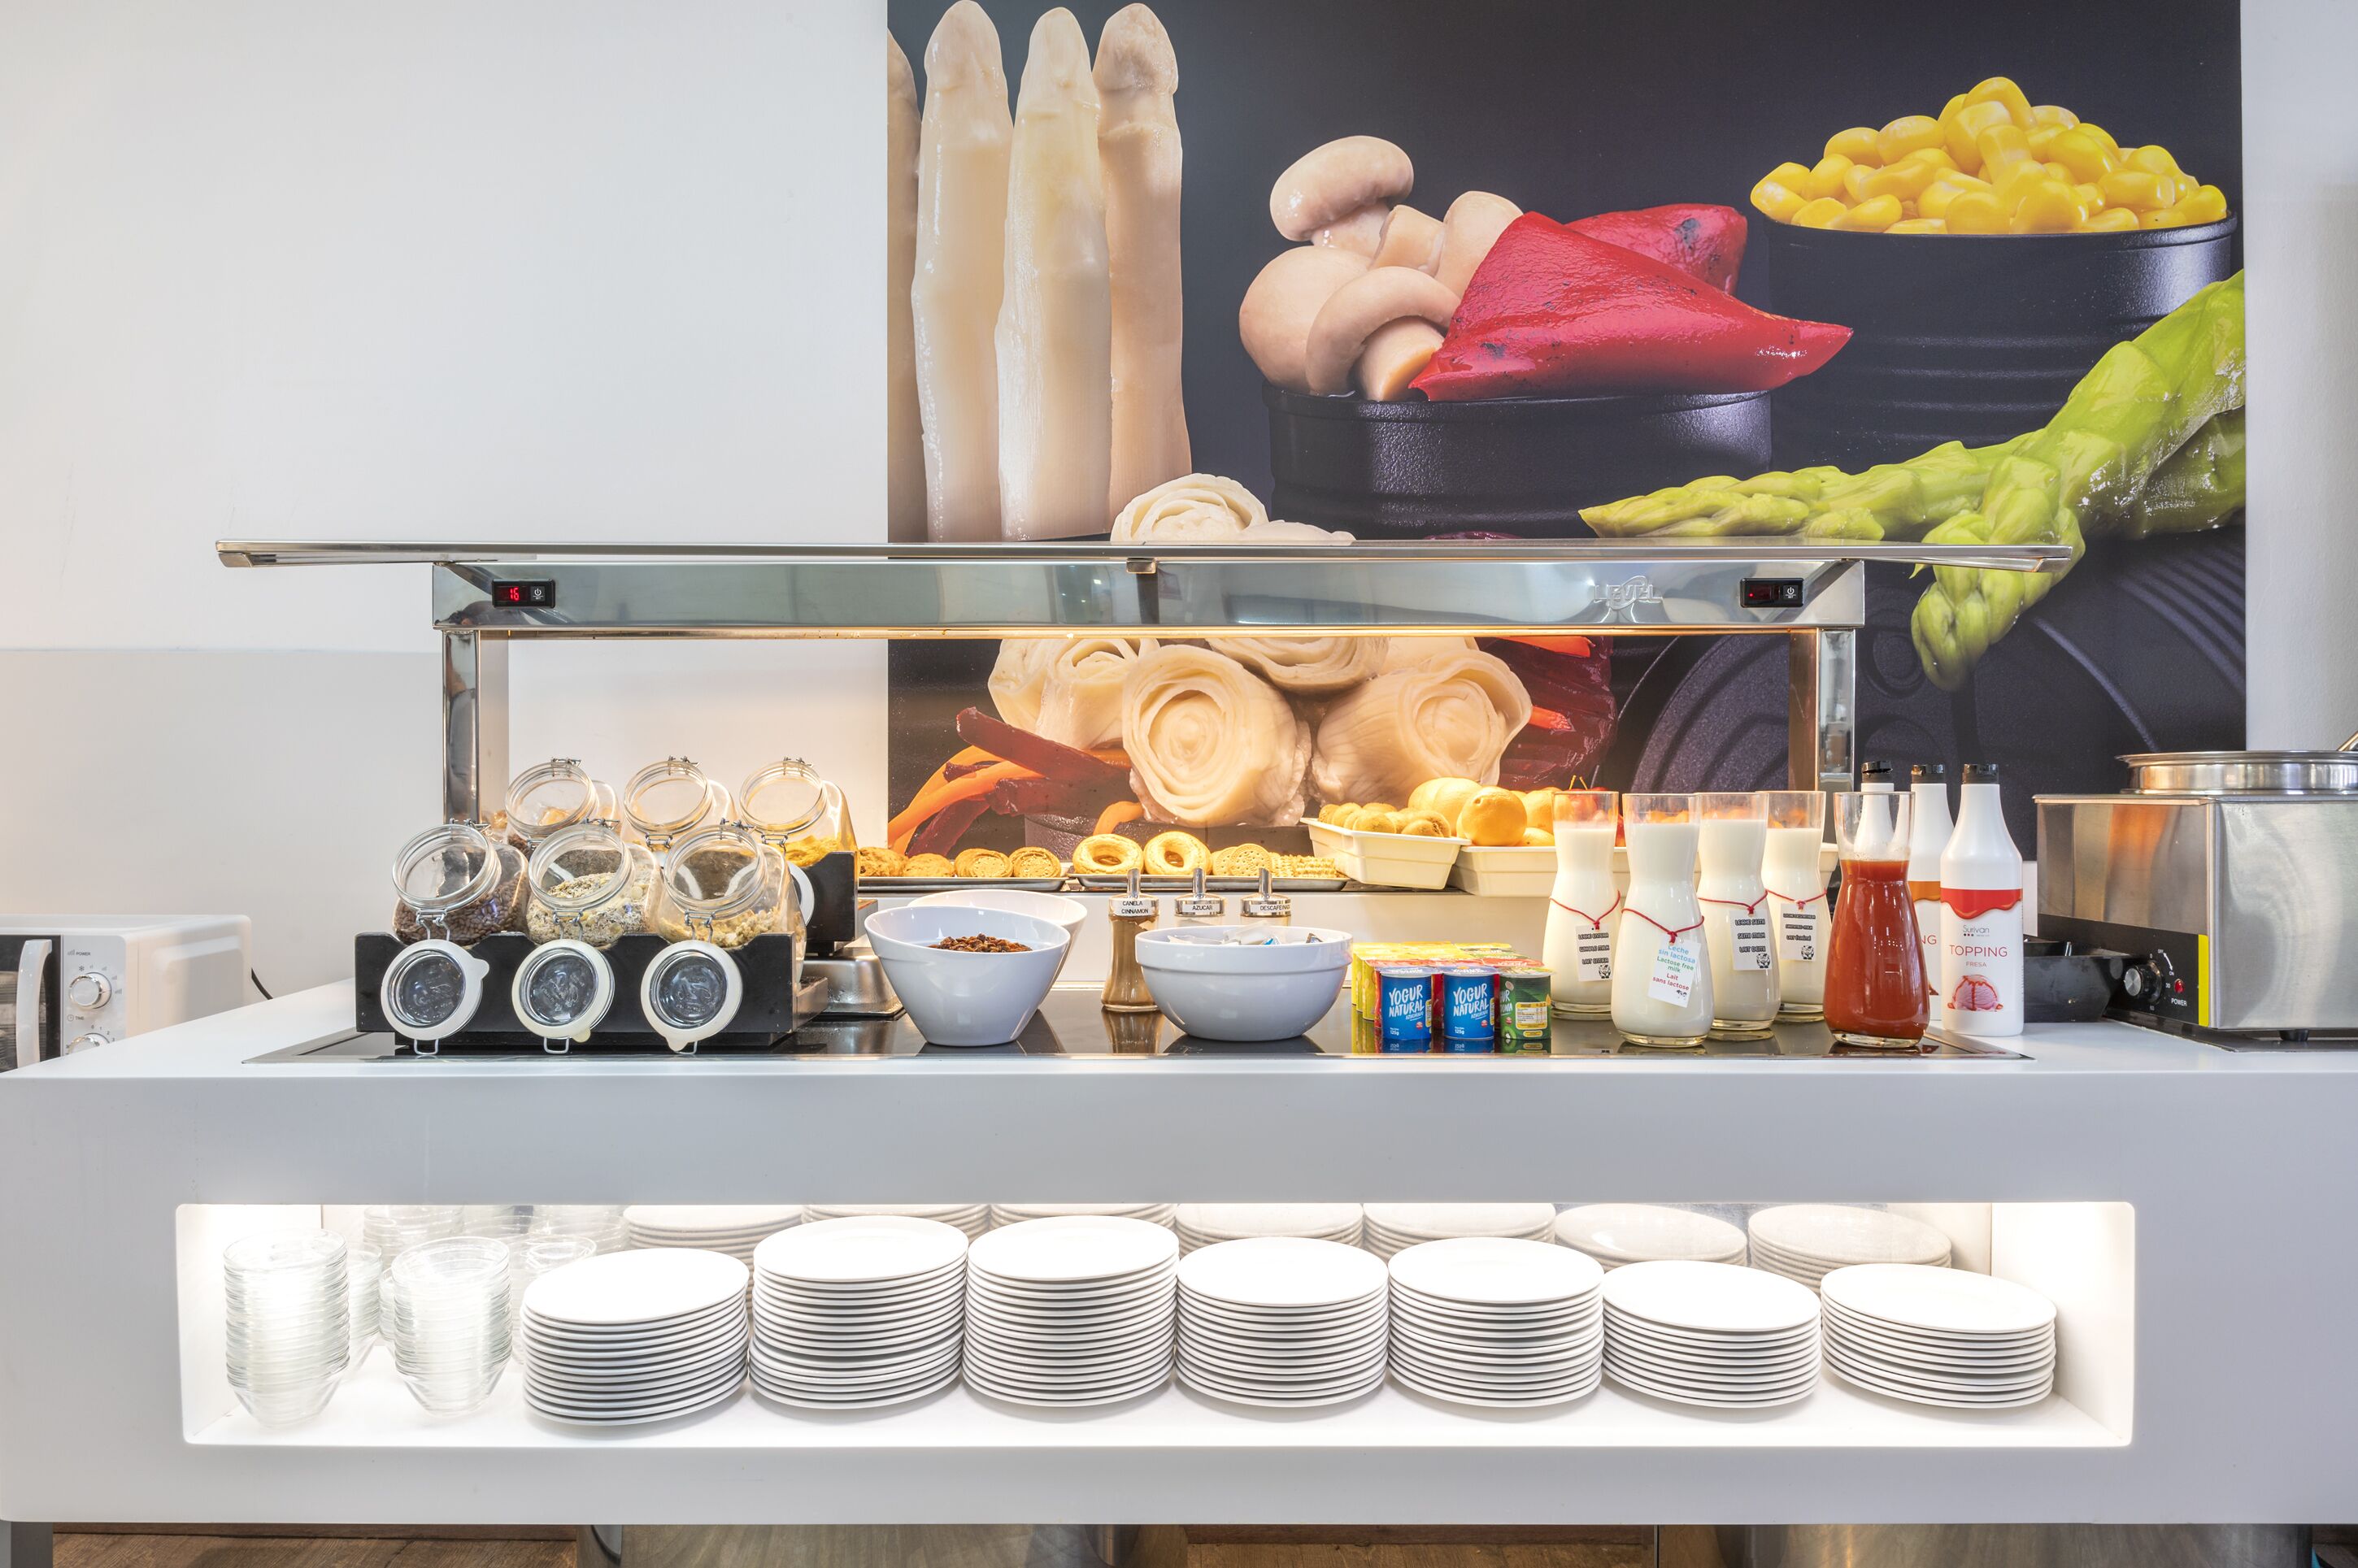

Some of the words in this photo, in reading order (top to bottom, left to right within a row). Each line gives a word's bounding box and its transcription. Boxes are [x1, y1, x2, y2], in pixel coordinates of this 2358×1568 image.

[510, 587, 520, 601] 16
[1594, 584, 1663, 602] LEVEL
[1963, 925, 1990, 933] Surivan
[1668, 945, 1689, 955] Leche
[1670, 951, 1695, 963] lactosa
[1950, 945, 2008, 958] TOPPING
[1657, 956, 1681, 966] Lactose
[1681, 962, 1694, 971] free
[1667, 980, 1690, 991] lactose
[1389, 984, 1423, 1006] YOGUR
[1453, 983, 1487, 1006] YOGUR
[2171, 997, 2187, 1006] POWER
[1389, 999, 1425, 1018] NATURAL
[1453, 997, 1489, 1017] NATURAL
